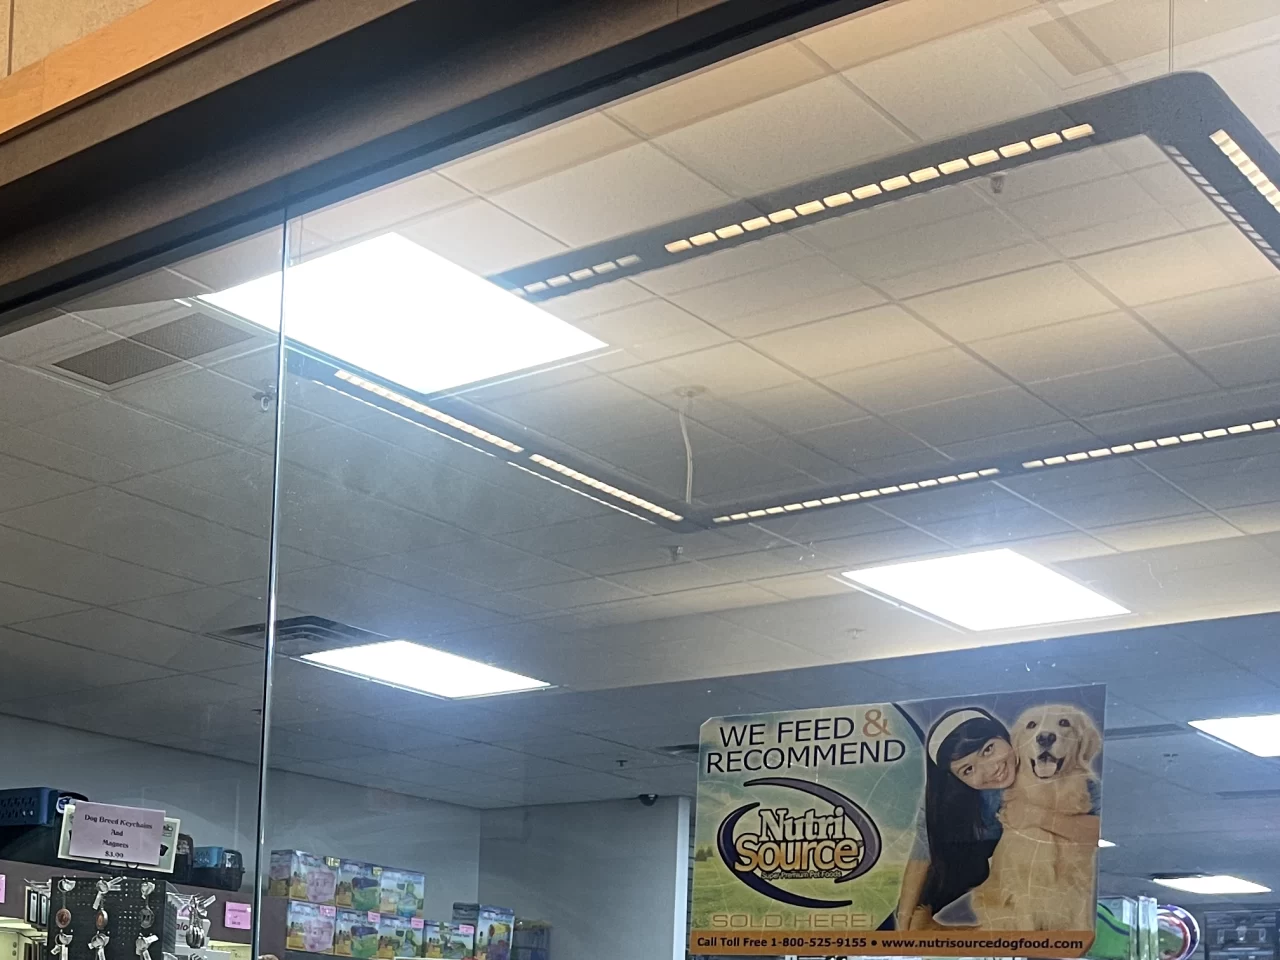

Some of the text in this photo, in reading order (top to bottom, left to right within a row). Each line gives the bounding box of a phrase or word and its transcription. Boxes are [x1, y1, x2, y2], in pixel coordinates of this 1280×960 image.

[719, 708, 891, 749] WE FEED &
[705, 738, 906, 774] RECOMMEND
[84, 814, 98, 824] Dog
[99, 816, 119, 826] Breed
[120, 819, 153, 830] Keychains
[758, 804, 847, 842] Nutri
[102, 839, 129, 849] Magnets
[734, 832, 861, 873] Source
[821, 870, 842, 878] Foods
[712, 913, 874, 928] SOLD HERE!
[696, 935, 1084, 951] Call Toll Free 1-800-525-9155 www.nutrisourcedogfood.com
